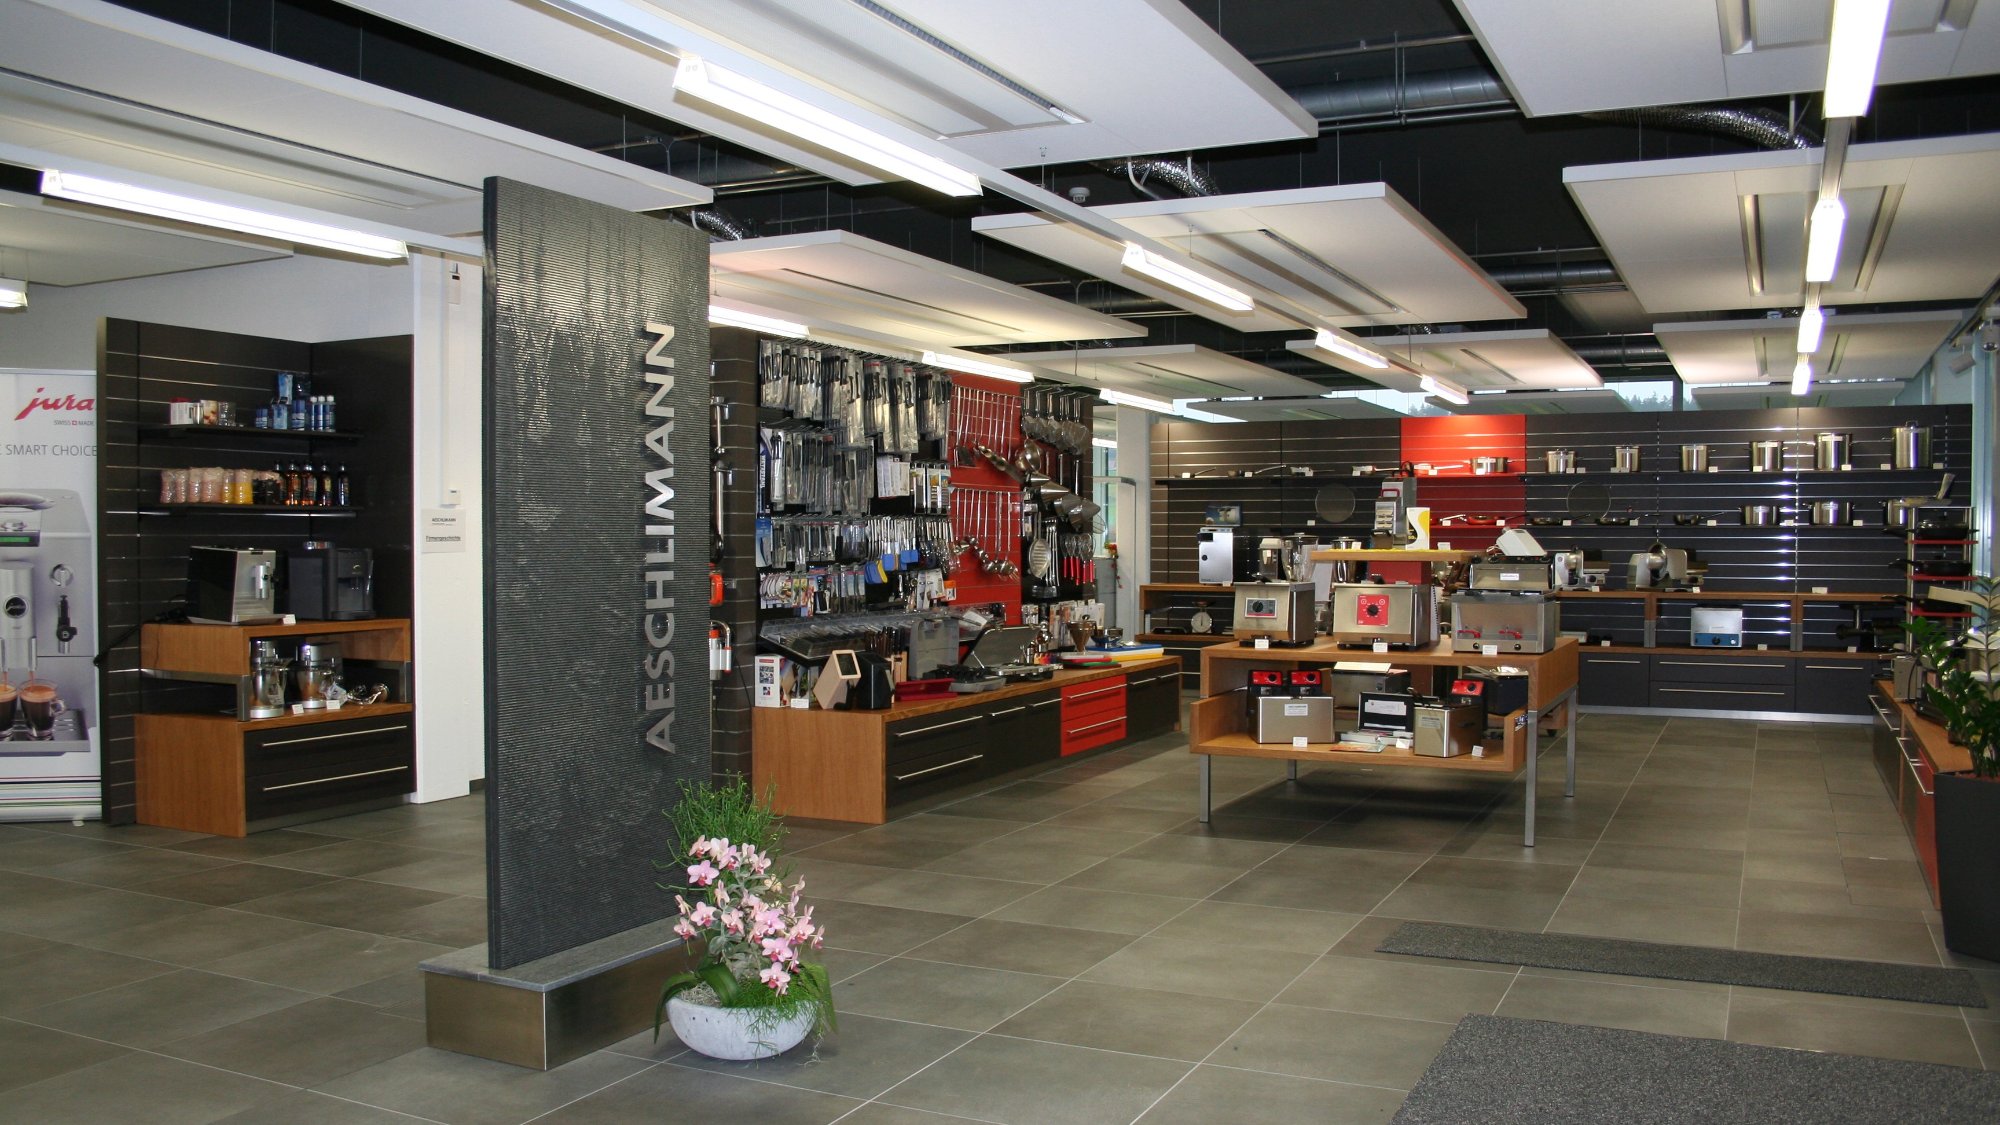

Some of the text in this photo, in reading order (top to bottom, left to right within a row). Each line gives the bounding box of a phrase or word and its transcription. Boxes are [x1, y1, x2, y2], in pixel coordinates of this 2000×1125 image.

[14, 387, 95, 421] jura
[6, 445, 48, 456] SMART
[52, 445, 97, 456] CHOICE
[645, 322, 676, 754] AESCHLIMANN
